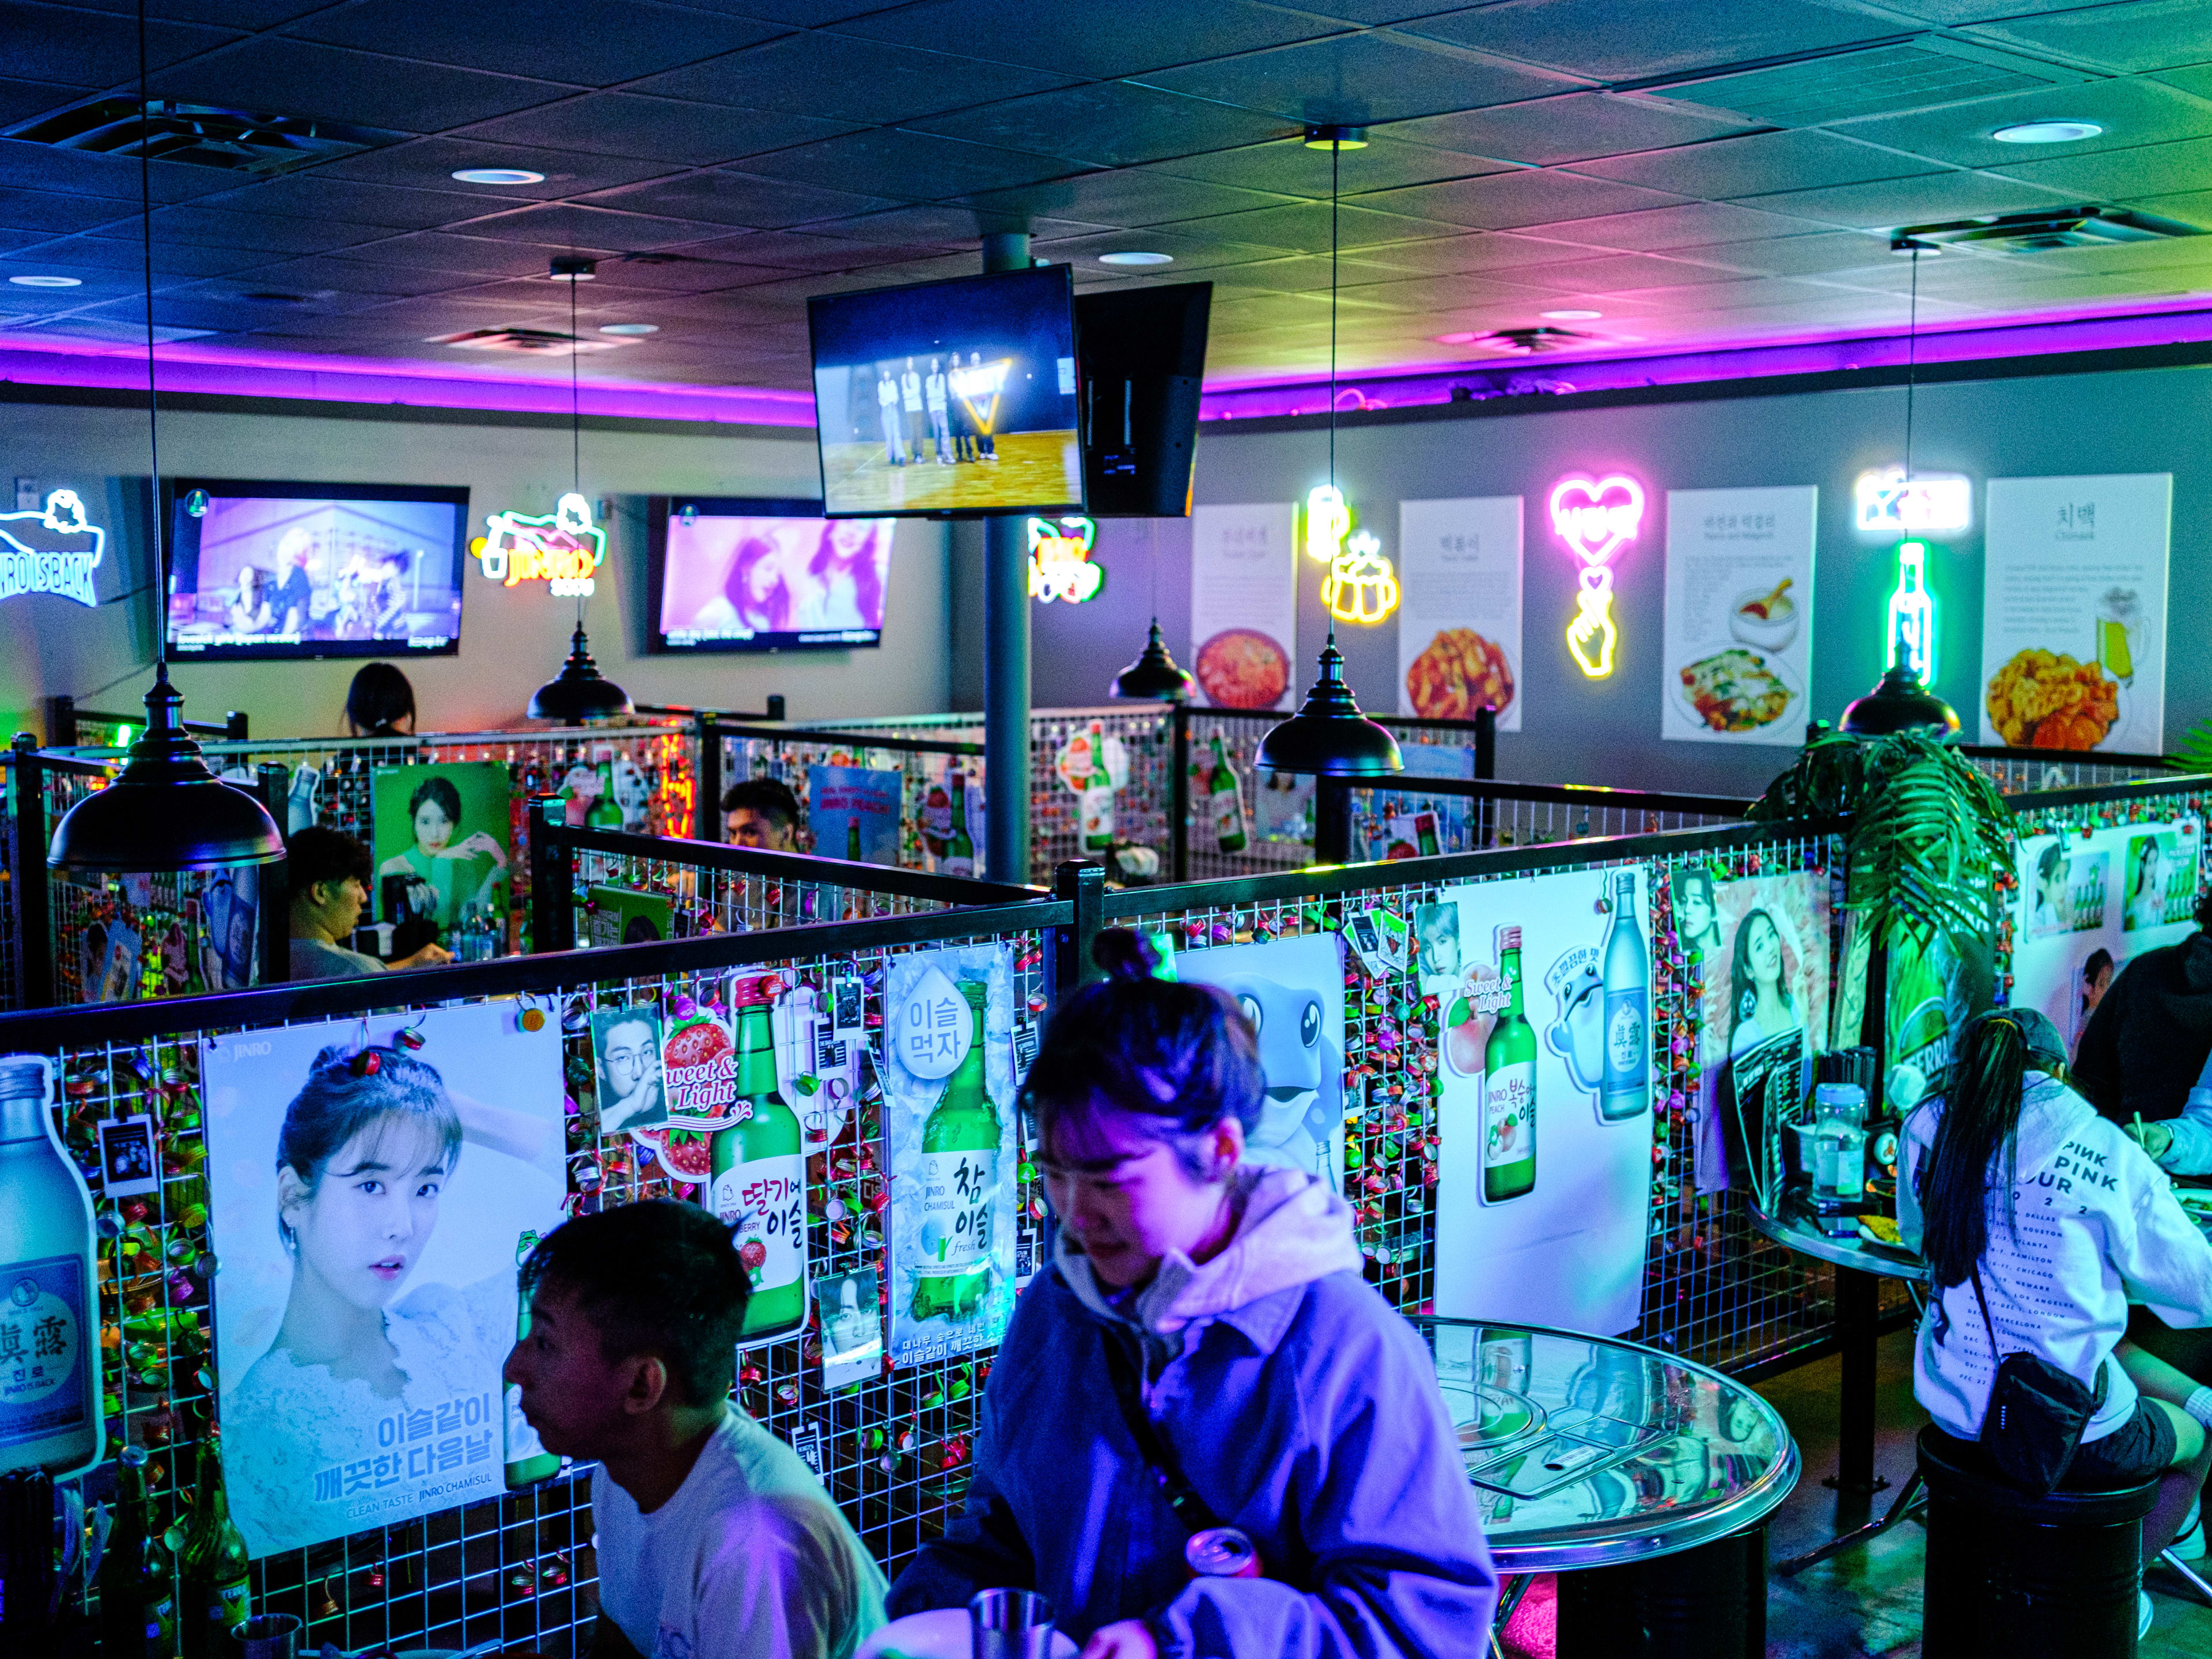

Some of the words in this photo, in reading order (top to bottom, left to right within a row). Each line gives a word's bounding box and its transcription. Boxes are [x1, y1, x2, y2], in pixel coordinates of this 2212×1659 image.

[48, 551, 97, 607] BACK
[1465, 979, 1499, 997] Sweet
[1501, 974, 1512, 990] &
[1479, 994, 1512, 1013] Light
[910, 997, 958, 1029] 이슬
[234, 1041, 271, 1062] JINRO
[911, 1030, 961, 1063] 먹자
[666, 1061, 716, 1088] weet
[719, 1058, 737, 1078] &
[676, 1081, 736, 1111] Light
[1489, 1105, 1505, 1114] PEACH
[953, 1157, 986, 1205] 참
[2054, 1155, 2119, 1192] PINK
[925, 1185, 945, 1200] JINRO
[924, 1200, 955, 1211] CHAMISUL
[767, 1199, 802, 1249] 이슬
[956, 1202, 988, 1249] 이슬
[2025, 1212, 2056, 1222] DALLAS
[739, 1221, 760, 1233] BERRY
[2022, 1226, 2063, 1238] HOUSTON
[951, 1240, 976, 1256] fresh
[2010, 1252, 2052, 1264] HAMILTON
[2016, 1267, 2054, 1279] CHICAGO
[2016, 1281, 2051, 1291] NEWARK
[2035, 1298, 2074, 1309] ANGELES
[2028, 1309, 2065, 1319] LONDON
[1965, 1321, 1980, 1330] DEC
[1995, 1316, 2041, 1330] BARCELONA
[902, 1343, 948, 1364] 이슬같이
[950, 1334, 984, 1353] 깨끗한
[903, 1335, 931, 1351] 대나무
[1959, 1373, 1972, 1381] DEC
[378, 1393, 491, 1448] 이슬같이
[315, 1450, 403, 1502] 깨끗한
[408, 1429, 494, 1479] 다음날
[346, 1500, 380, 1520] CLEAN
[381, 1493, 414, 1509] TASTE
[418, 1485, 444, 1503] JINRO
[445, 1472, 493, 1494] CHAMISUL
